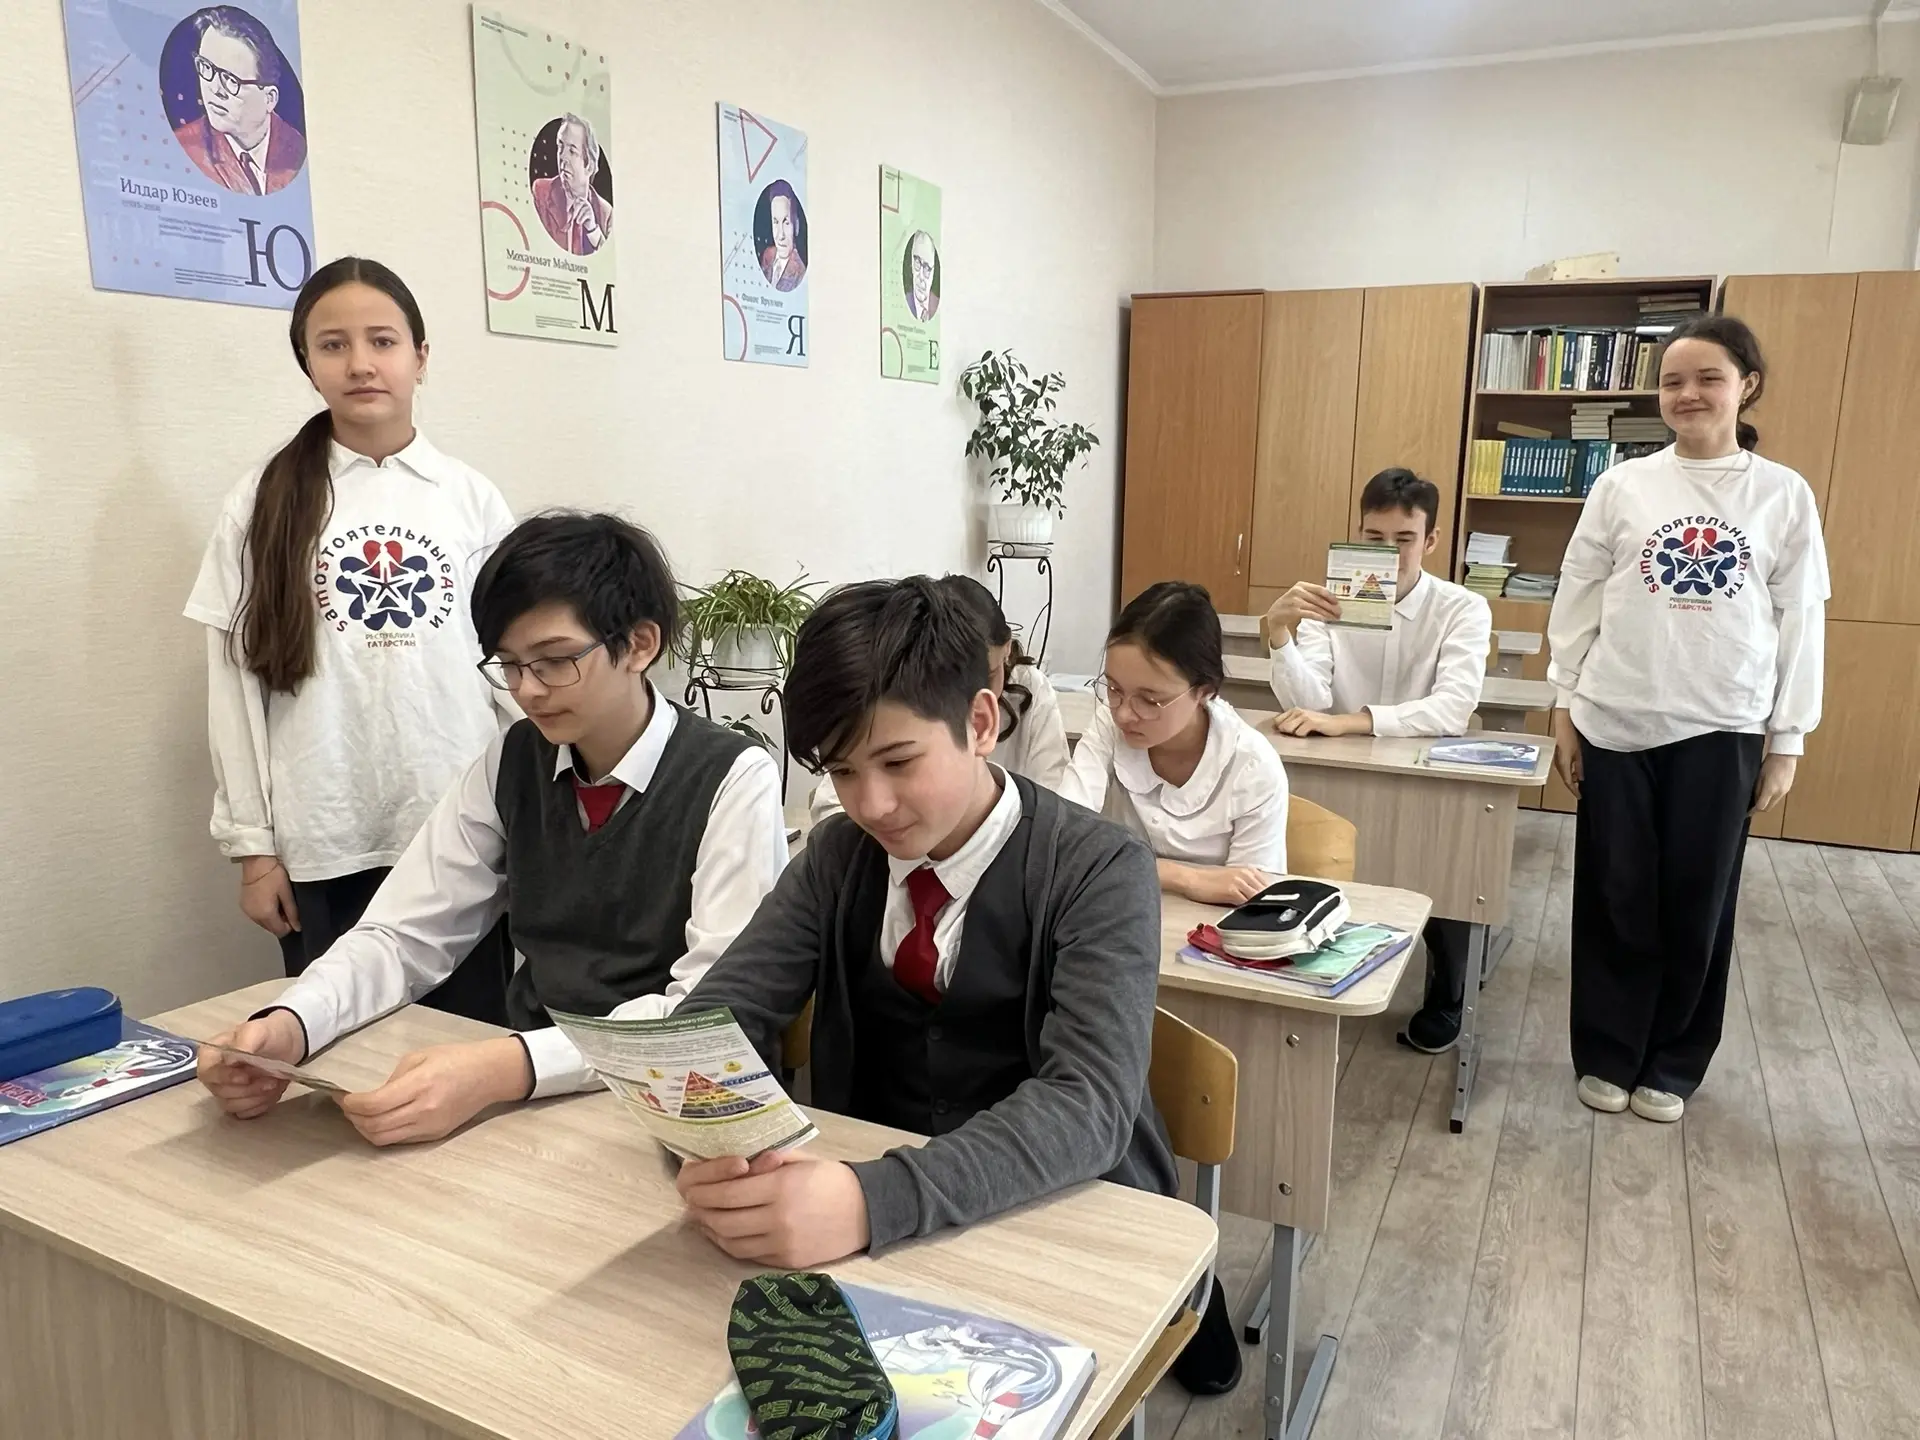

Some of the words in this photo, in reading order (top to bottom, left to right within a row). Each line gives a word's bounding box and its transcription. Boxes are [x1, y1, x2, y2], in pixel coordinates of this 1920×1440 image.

[120, 177, 168, 202] Илдар
[172, 187, 218, 209] Юзеев
[238, 217, 312, 292] Ю
[786, 315, 806, 356] Я
